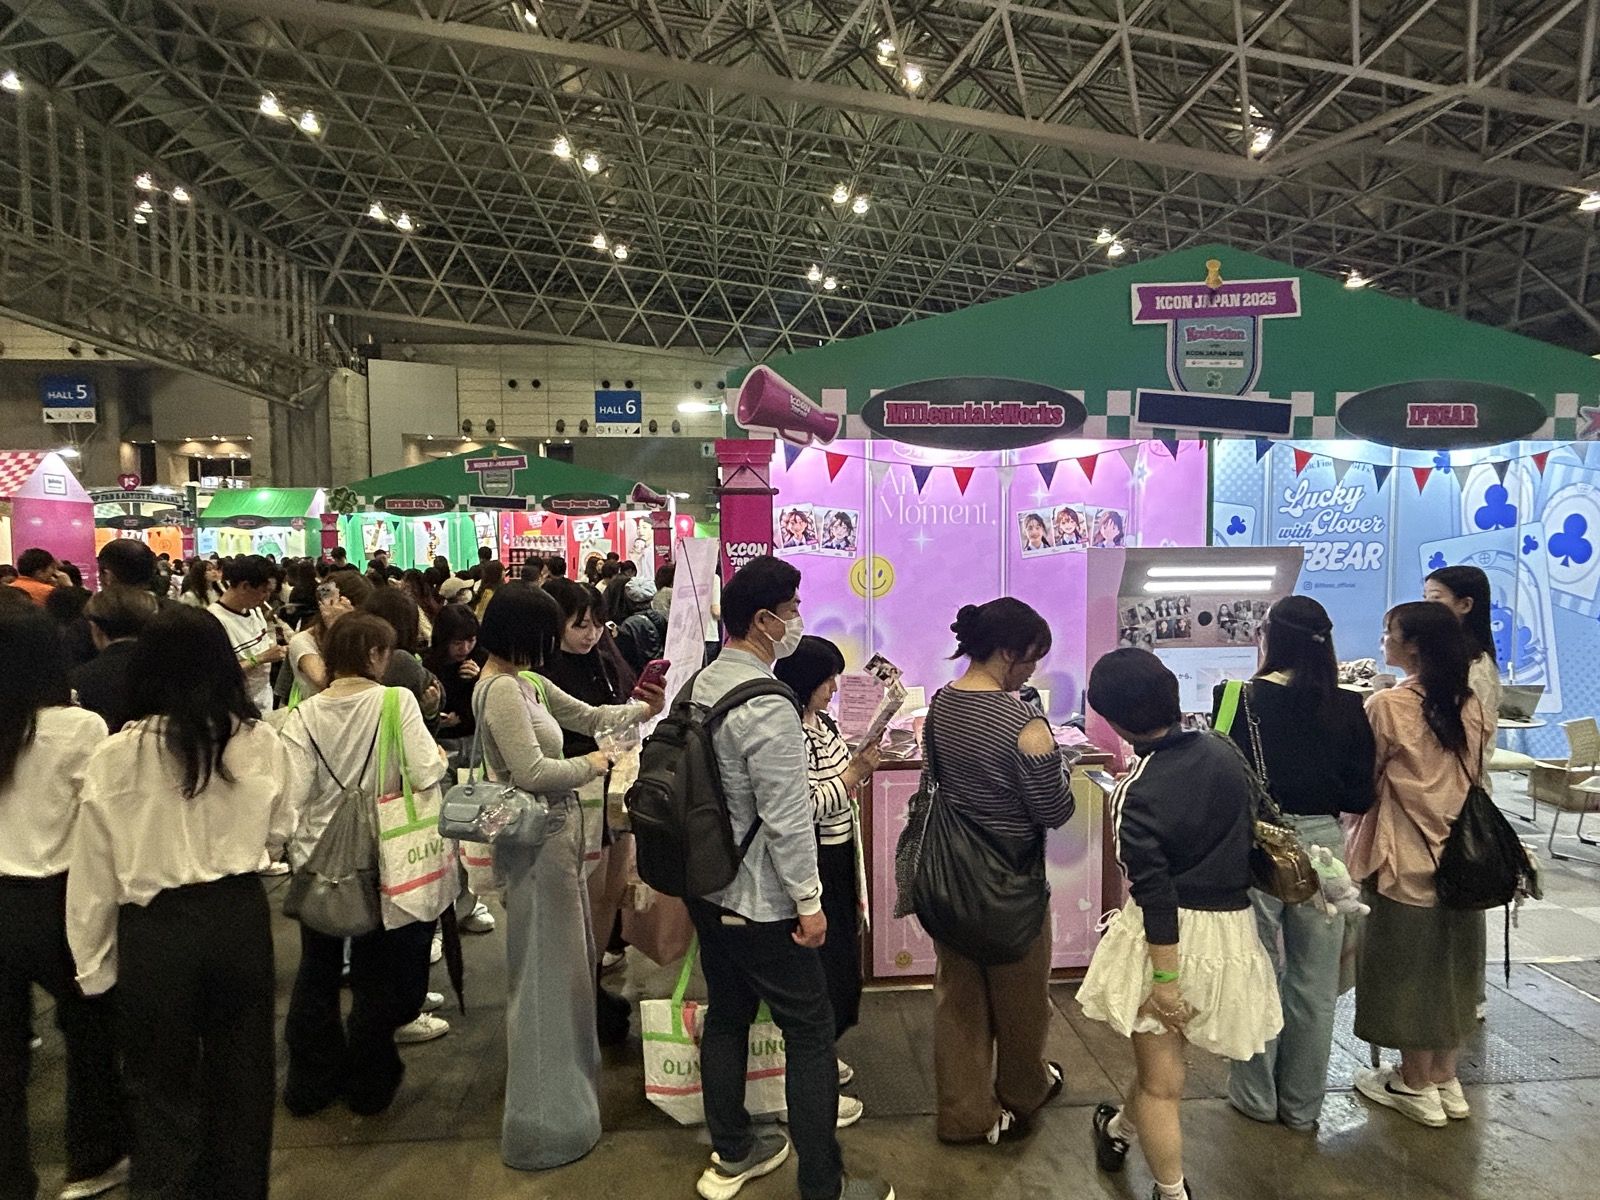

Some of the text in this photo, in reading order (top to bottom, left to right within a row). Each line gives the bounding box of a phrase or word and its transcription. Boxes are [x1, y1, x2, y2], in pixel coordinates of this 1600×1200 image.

[1155, 292, 1277, 310] KCON JAPAN 2025
[48, 384, 88, 400] HALL 5
[599, 399, 637, 415] HALL 6
[885, 402, 1064, 426] MillennialsWorks
[1408, 404, 1478, 427] IFBEAR
[1280, 479, 1365, 518] Lucky
[880, 495, 996, 525] Moment.
[1279, 523, 1314, 539] with
[1311, 509, 1385, 536] Clover
[725, 542, 768, 557] KCON
[1289, 541, 1385, 572] FBEAR
[730, 557, 754, 566] JAP
